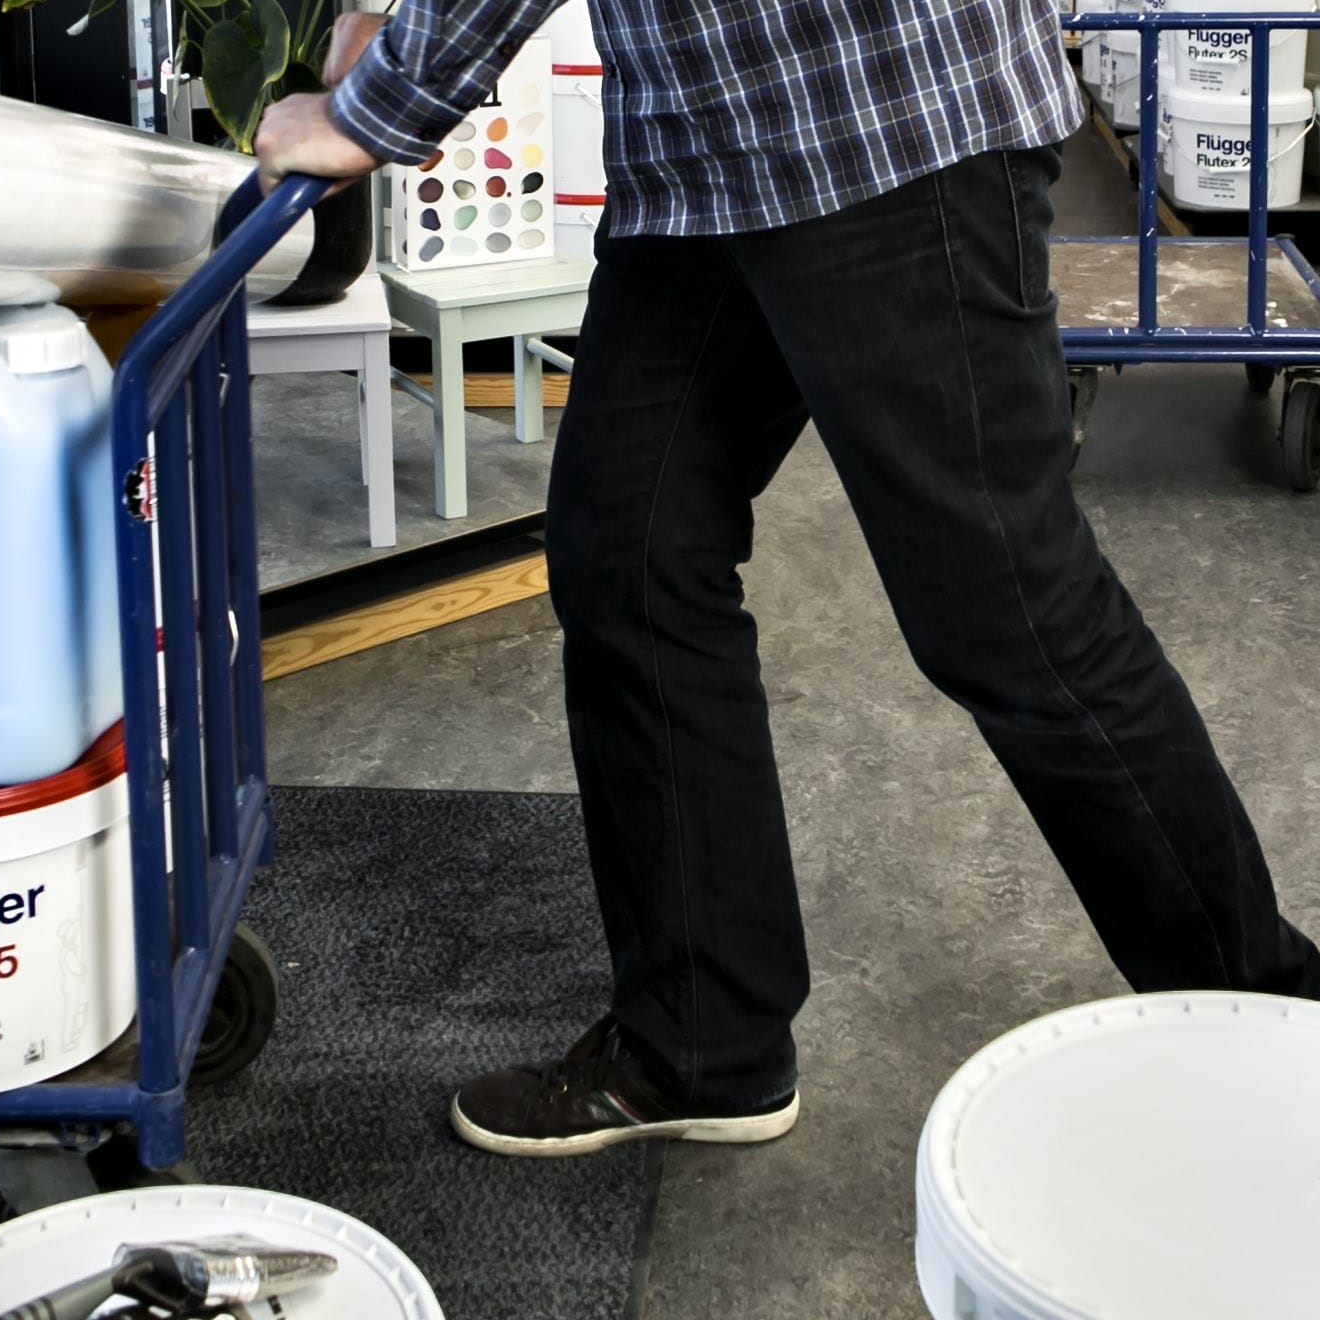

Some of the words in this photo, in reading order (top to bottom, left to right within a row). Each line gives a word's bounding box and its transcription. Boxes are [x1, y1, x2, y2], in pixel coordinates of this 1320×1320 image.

[1188, 29, 1253, 48] Flügger
[1197, 133, 1253, 156] Flügge
[1197, 154, 1237, 167] Flutex
